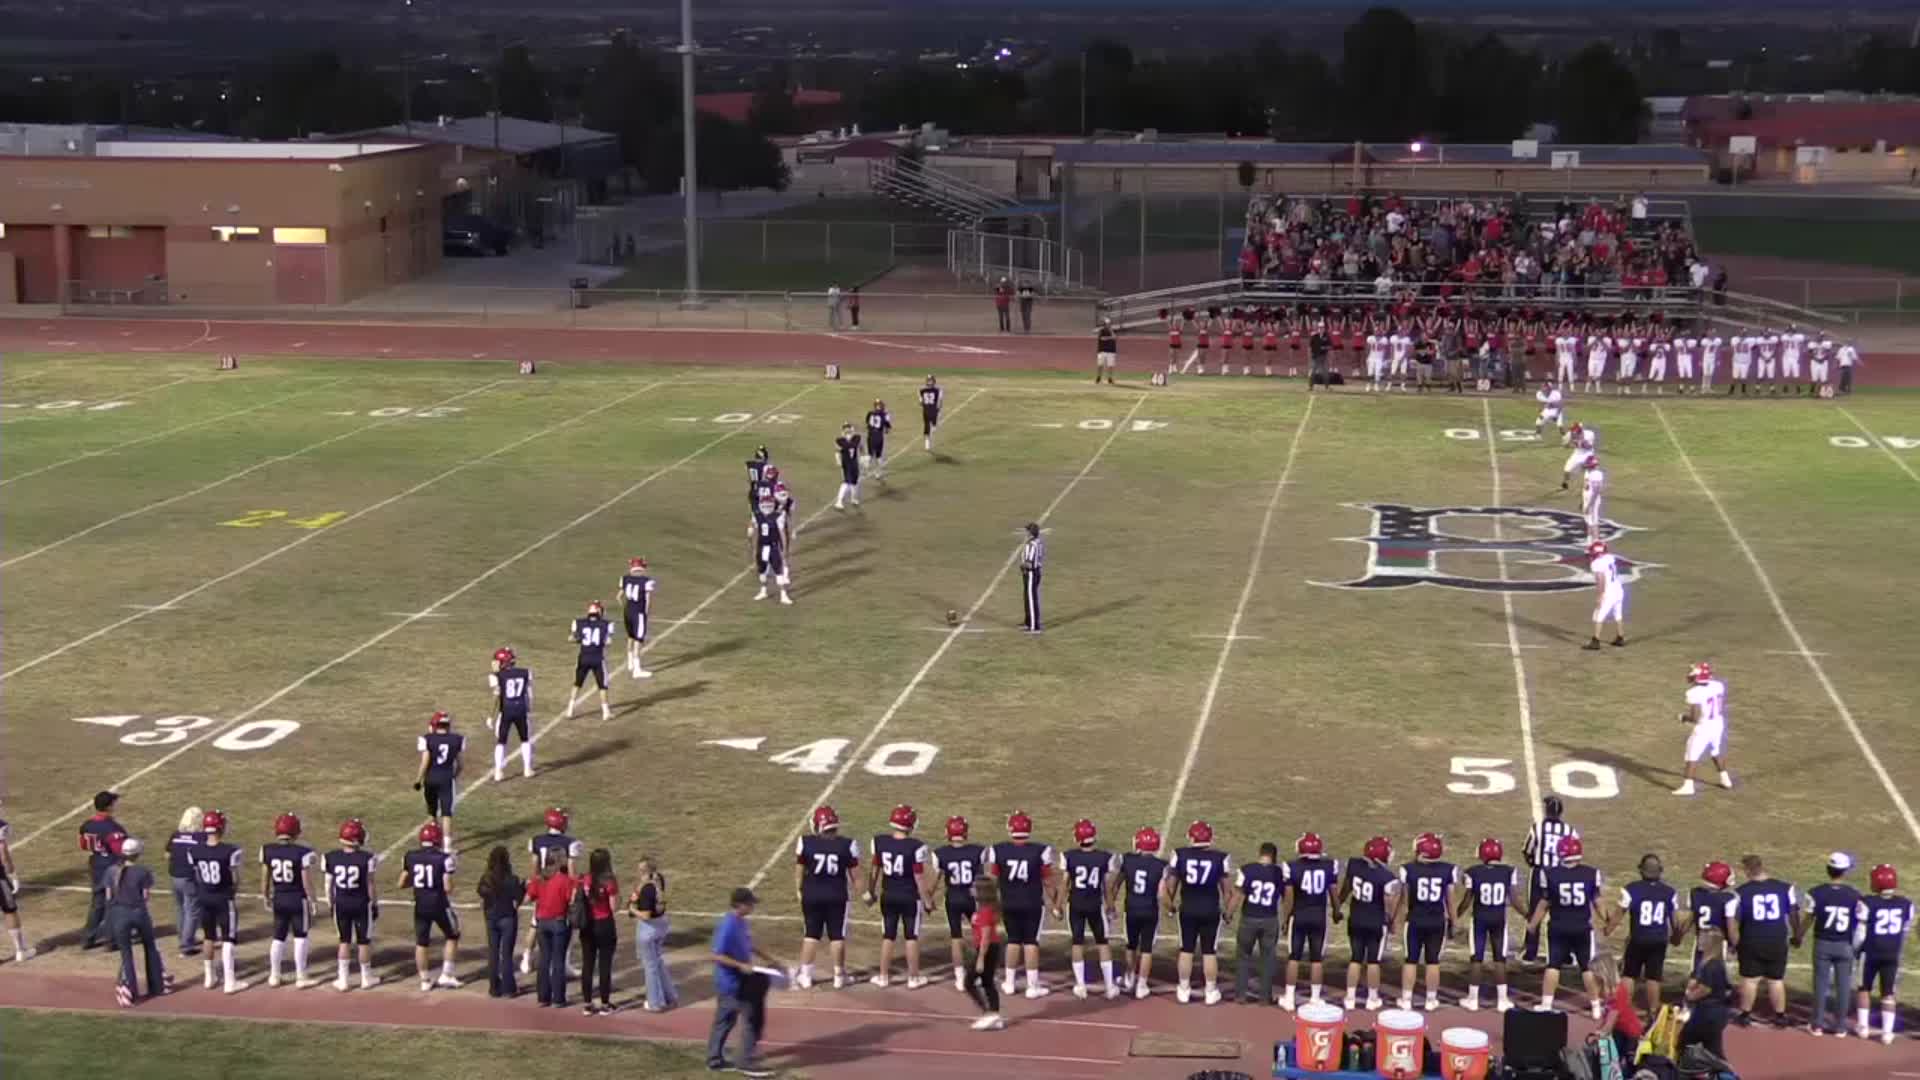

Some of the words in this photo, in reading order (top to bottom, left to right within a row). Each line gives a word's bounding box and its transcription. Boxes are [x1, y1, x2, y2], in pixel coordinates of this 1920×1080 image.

[581, 626, 601, 646] 34
[505, 678, 524, 698] 87
[120, 715, 301, 751] 30
[437, 744, 449, 764] 3
[768, 738, 940, 776] 40
[1446, 757, 1620, 798] 50
[198, 861, 221, 884] 88
[271, 859, 294, 883] 26
[814, 853, 839, 875] 76
[882, 852, 904, 875] 54
[949, 862, 971, 884] 36
[1007, 860, 1029, 882] 74
[1187, 860, 1212, 884] 57
[335, 866, 359, 889] 22
[413, 864, 433, 888] 21
[1075, 866, 1099, 889] 24
[1134, 870, 1147, 894] 5
[1301, 869, 1325, 894] 40
[1249, 881, 1276, 905] 33
[1417, 877, 1442, 902] 65
[1480, 881, 1505, 906] 80
[1559, 883, 1586, 906] 55
[1640, 900, 1665, 926] 84
[1698, 904, 1712, 929] 2
[1752, 894, 1780, 920] 63
[1824, 906, 1849, 931] 75
[1875, 909, 1902, 934] 25
[1391, 1041, 1411, 1058] G
